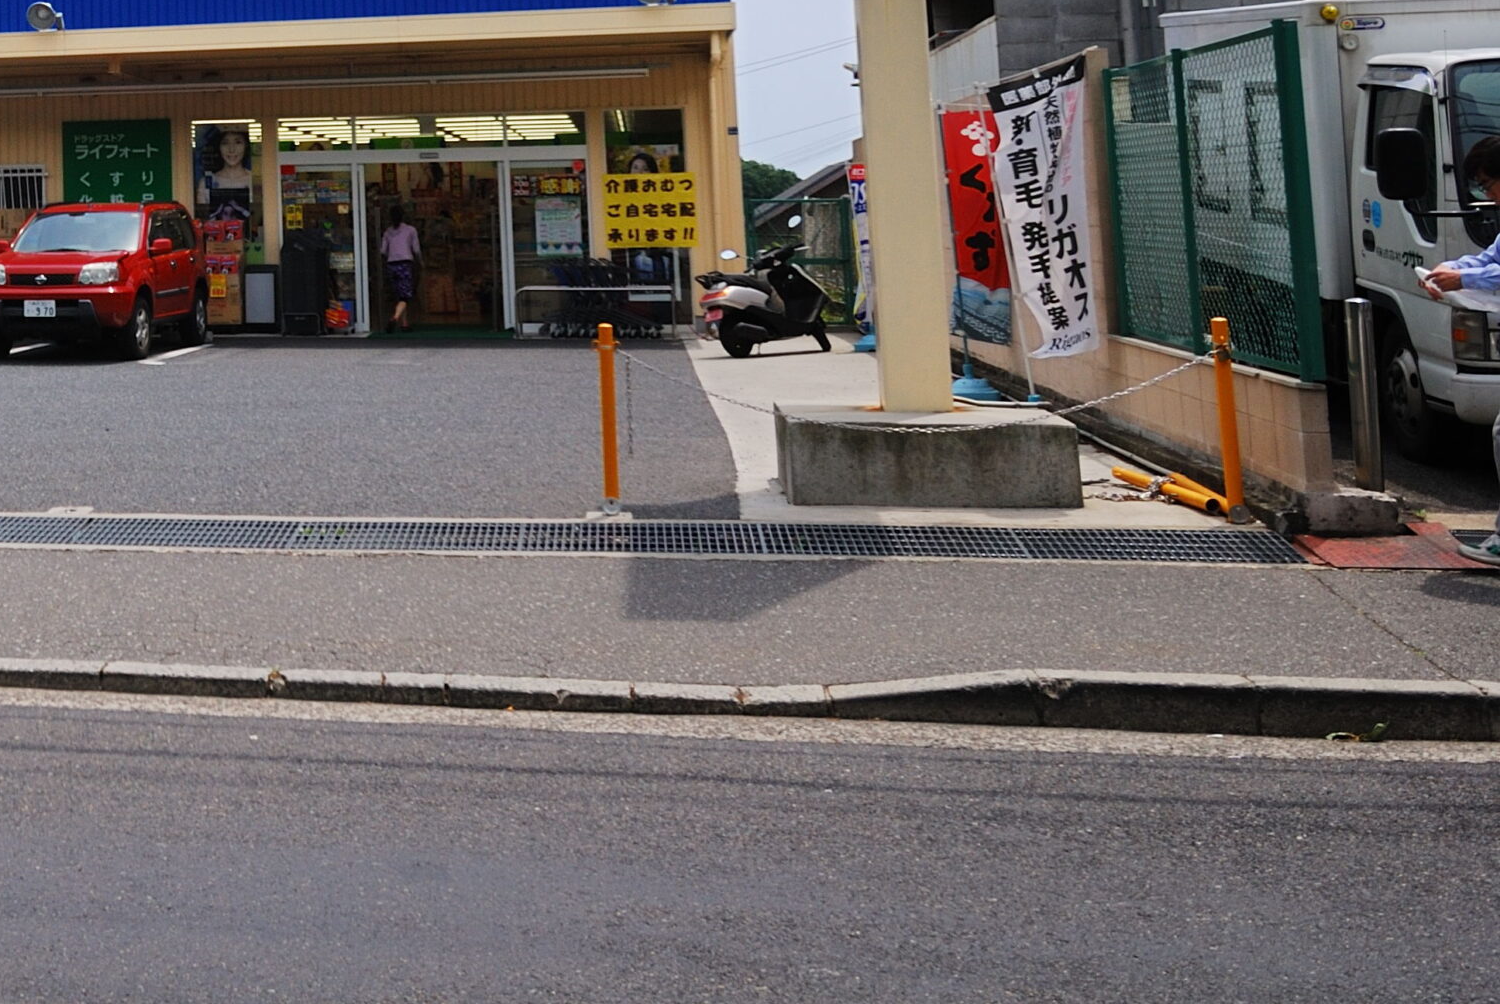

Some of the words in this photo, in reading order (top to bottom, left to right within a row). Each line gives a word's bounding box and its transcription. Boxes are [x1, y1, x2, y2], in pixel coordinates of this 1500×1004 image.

[75, 143, 159, 160] ライフォート
[80, 171, 154, 187] くすり
[605, 178, 693, 193] 介護おむつ
[606, 202, 696, 218] ご自宅宅配
